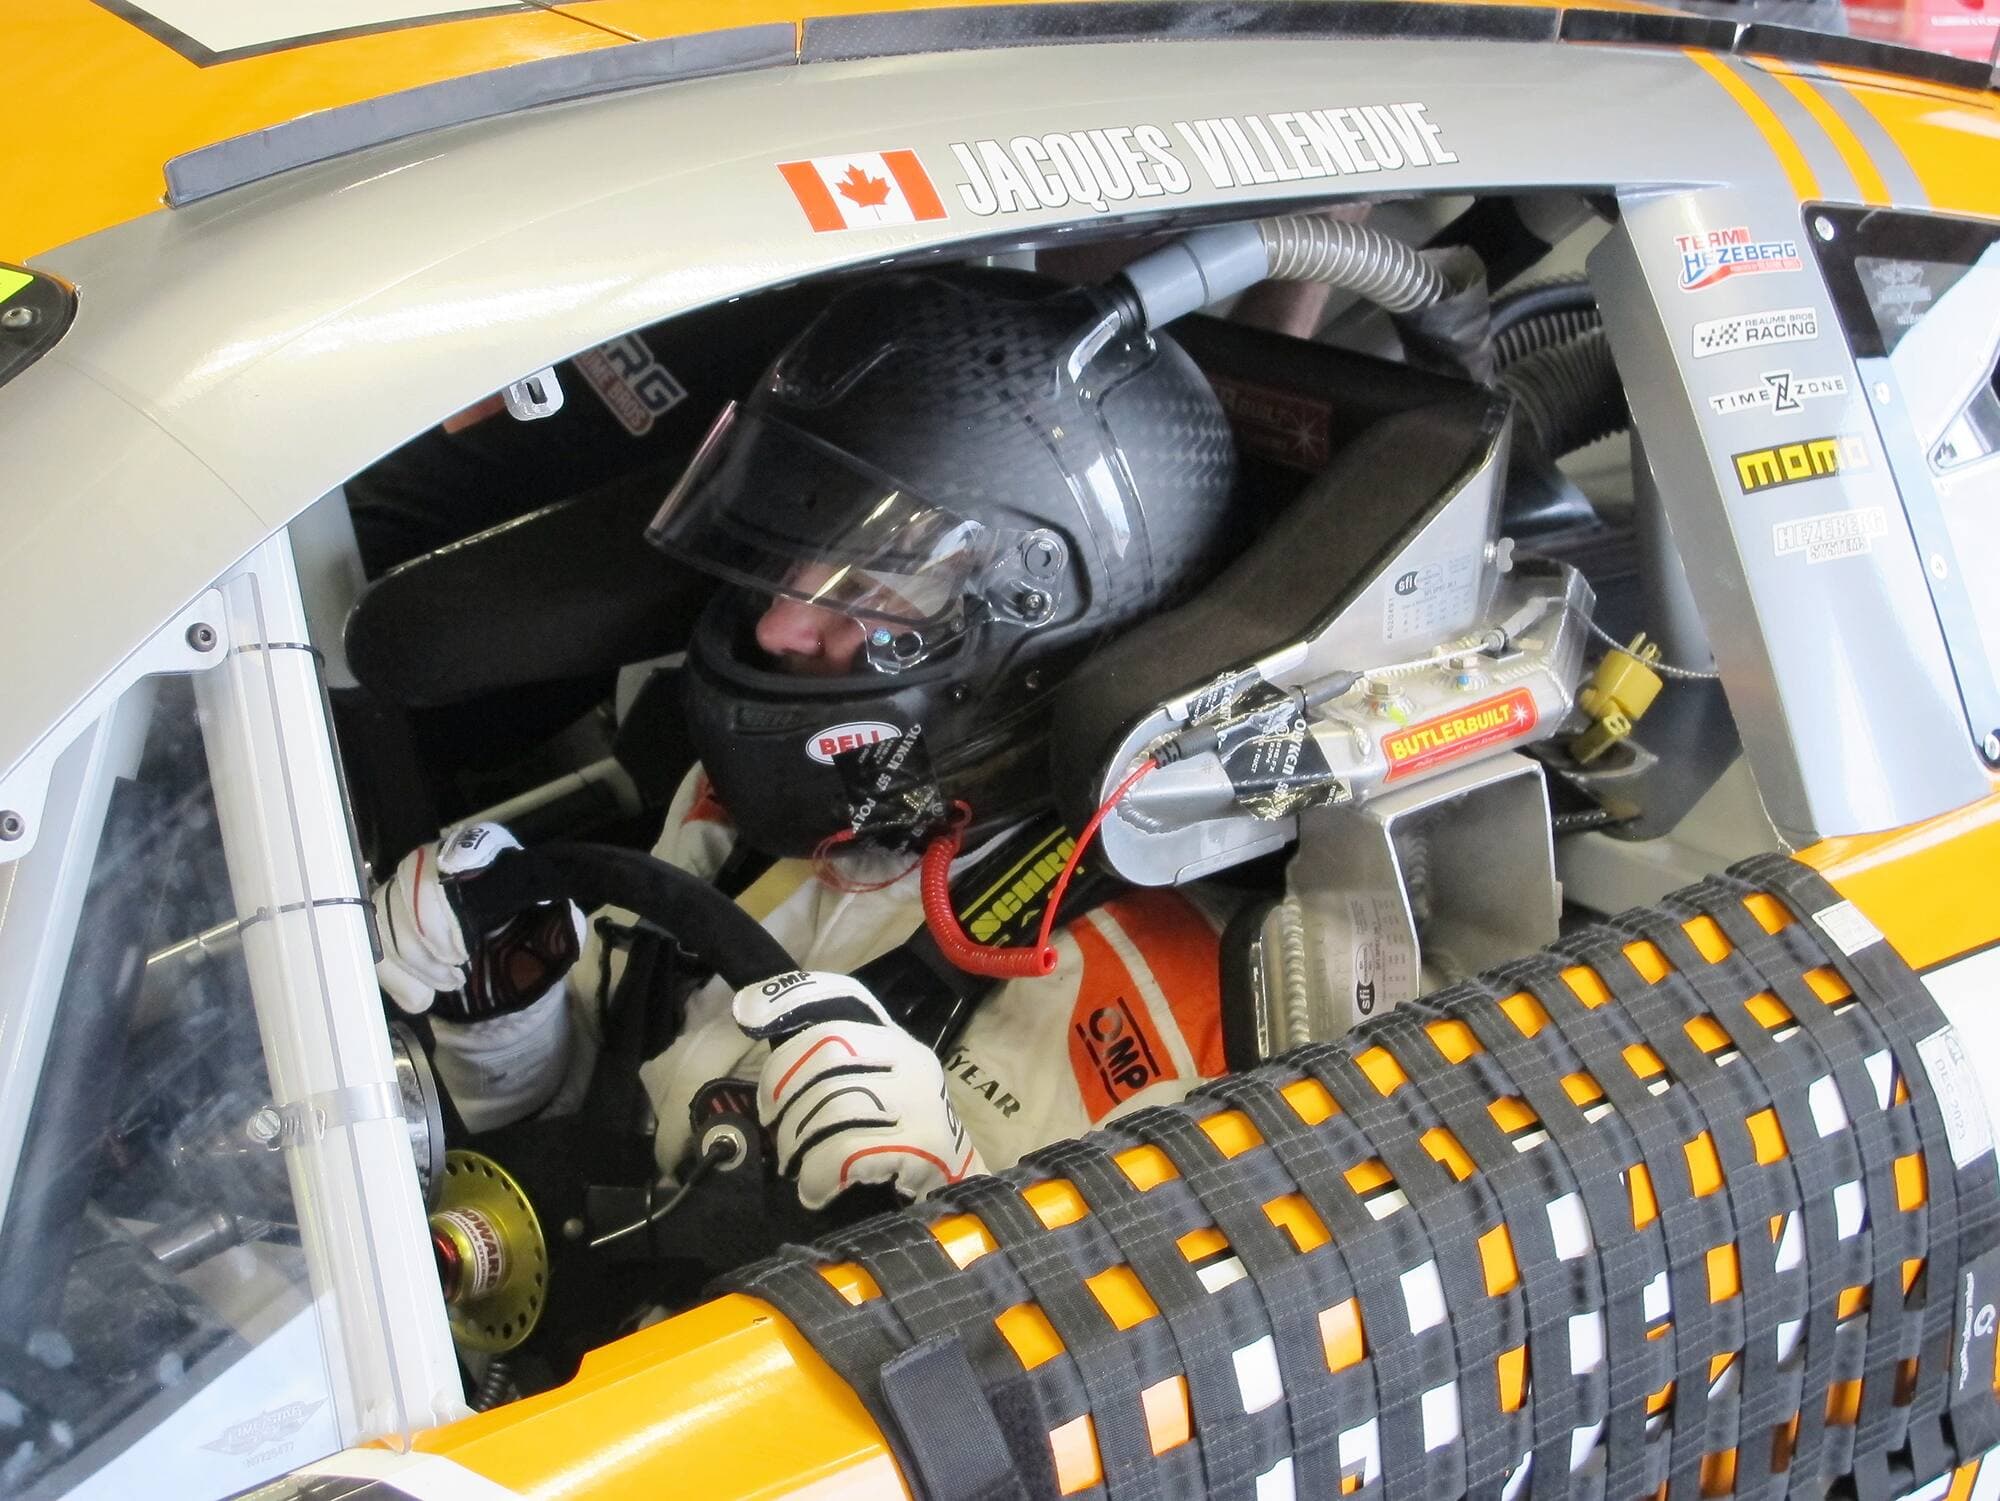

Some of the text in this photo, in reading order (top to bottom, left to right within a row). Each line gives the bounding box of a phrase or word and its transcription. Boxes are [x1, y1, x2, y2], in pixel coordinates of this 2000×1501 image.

[949, 101, 1459, 216] JACQUES VILLENEUVE
[1676, 229, 1741, 252] TEAM
[1684, 243, 1797, 273] HEZEBERG
[1745, 312, 1814, 327] REAUME BROS
[1746, 321, 1817, 342] RACING
[1713, 389, 1771, 410] TIME
[1794, 378, 1845, 396] ZONE
[1775, 510, 1885, 551] HEZEBERG
[1391, 704, 1512, 761] BUTLERBUILT
[762, 971, 811, 996] OMP
[1360, 988, 1371, 1010] sfi
[1088, 1007, 1149, 1090] OMP
[947, 1046, 1022, 1120] YEAR
